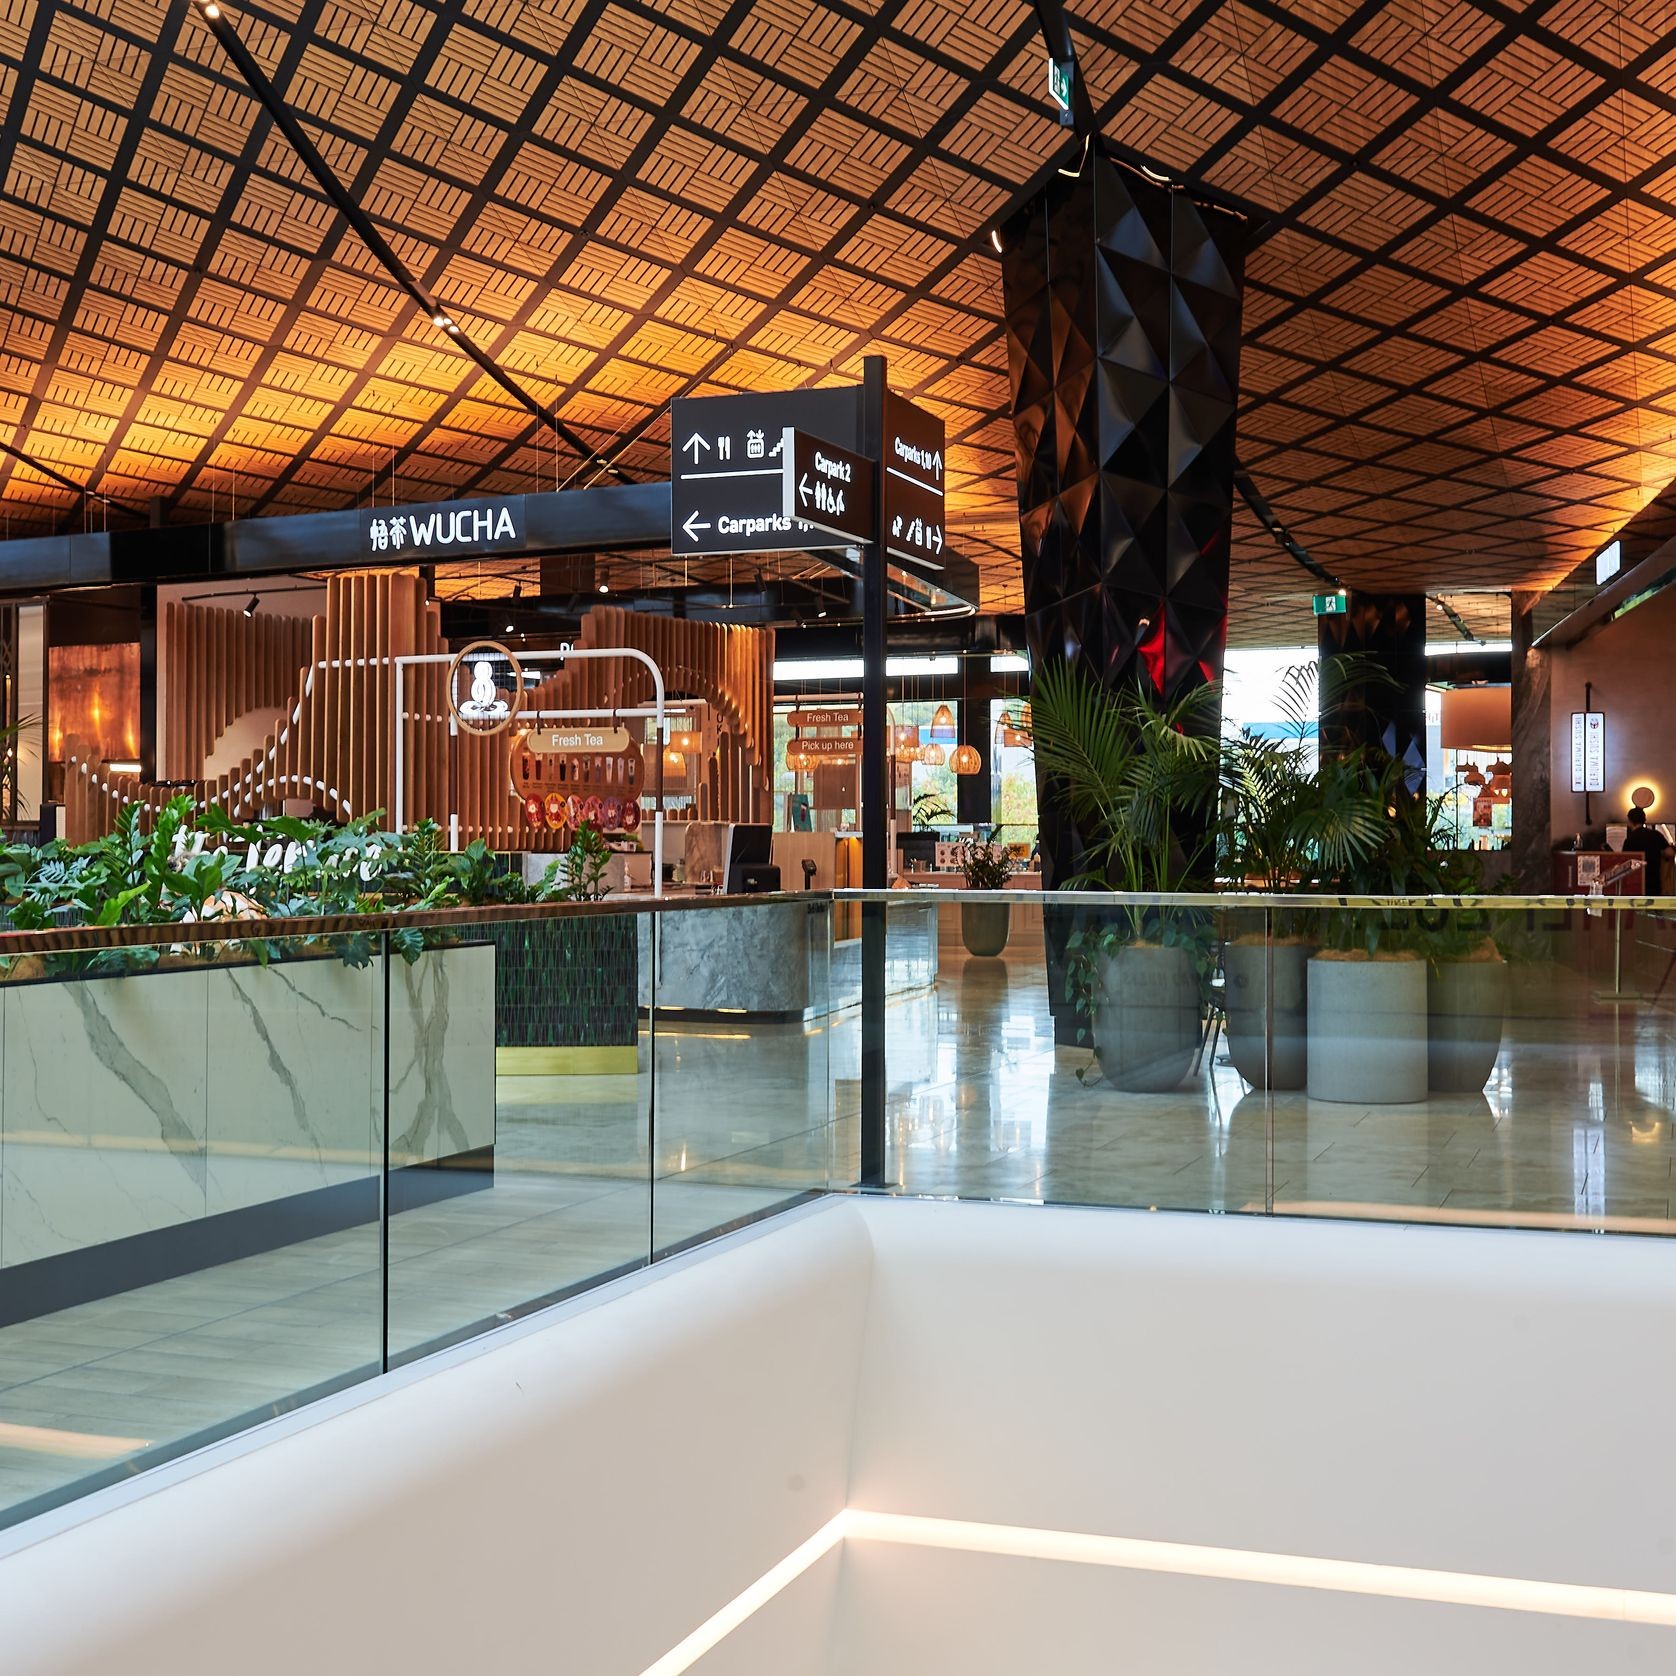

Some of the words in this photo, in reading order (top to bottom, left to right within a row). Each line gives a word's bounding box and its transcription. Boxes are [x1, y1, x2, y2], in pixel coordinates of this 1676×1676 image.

[895, 436, 920, 465] Carparks
[815, 451, 844, 479] Carpark
[845, 463, 851, 483] 2
[369, 515, 408, 552] 悟茶
[409, 506, 516, 547] WUCHA
[718, 512, 792, 537] Carparks
[807, 712, 831, 722] Fresh
[833, 711, 849, 722] Tea
[552, 734, 582, 747] Fresh
[584, 733, 603, 746] Tea
[801, 740, 820, 750] Pick
[821, 742, 833, 752] up
[834, 740, 854, 750] here
